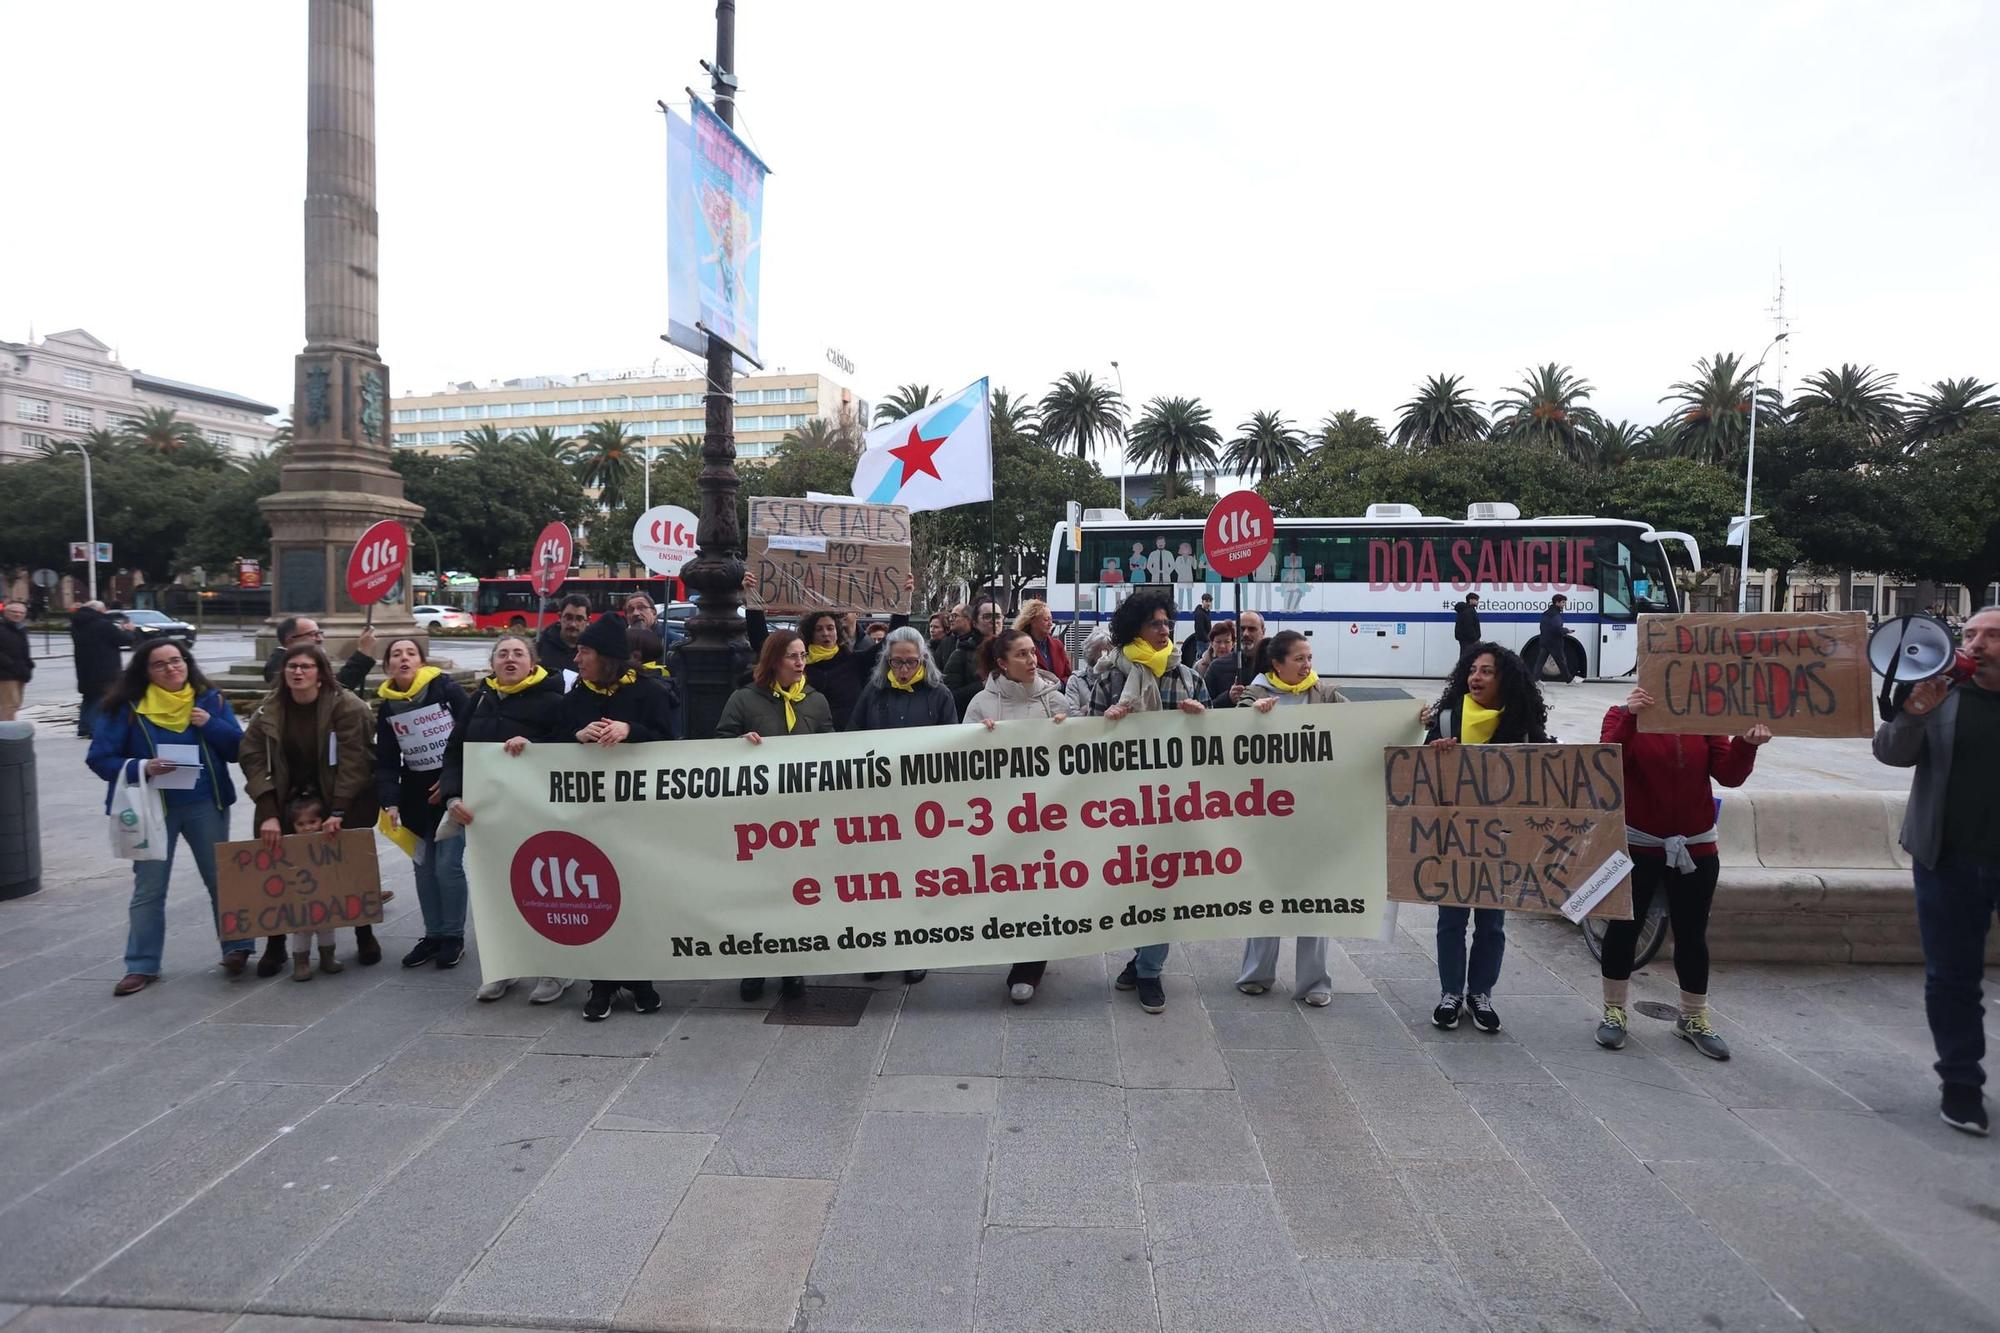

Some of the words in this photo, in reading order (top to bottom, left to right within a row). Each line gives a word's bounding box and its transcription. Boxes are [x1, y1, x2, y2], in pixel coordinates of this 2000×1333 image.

[650, 520, 694, 548] CIG
[1218, 510, 1261, 544] CIG
[361, 538, 398, 574] CIG
[658, 552, 683, 561] ENSINO
[827, 544, 869, 565] MOI
[1229, 549, 1252, 561] ENSINO
[1369, 540, 1440, 592] DOA
[1452, 539, 1595, 592] SANGUE
[1647, 619, 1838, 658] EDUCADORAS
[1664, 660, 1837, 719] CABREADAS
[549, 771, 606, 802] REDE
[615, 770, 647, 802] DE
[656, 764, 769, 800] ESCOLAS
[778, 750, 892, 793] INFANTÍS
[901, 745, 1050, 785] MUNICIPAIS
[1059, 737, 1183, 776] CONCELLO
[1192, 735, 1224, 766] DA
[1233, 724, 1333, 765] CORUÑA
[1386, 747, 1622, 811] CALADIÑAS
[734, 817, 820, 861] por
[835, 812, 901, 845] un
[914, 797, 994, 838] 0-3
[1007, 792, 1067, 834] de
[1080, 778, 1295, 830] calidade
[1410, 811, 1507, 858] MÁIS
[232, 847, 294, 872] POR
[308, 841, 342, 866] UN
[530, 857, 600, 899] CIG
[792, 876, 821, 906] e
[835, 870, 901, 902] un
[915, 849, 1089, 898] salario
[1102, 844, 1242, 889] digno
[1413, 856, 1572, 911] GUAPAS
[222, 909, 252, 935] DE
[258, 890, 382, 931] CALIDADE
[546, 912, 589, 925] ENSINO
[671, 937, 712, 957] Na
[719, 933, 830, 955] defensa
[837, 927, 887, 949] dos
[894, 924, 974, 946] nosos
[982, 914, 1092, 940] dereitos
[1099, 915, 1114, 930] e
[1120, 905, 1167, 927] dos
[1173, 900, 1252, 921] nenos
[1259, 899, 1274, 914] e
[1281, 897, 1366, 914] nenas
